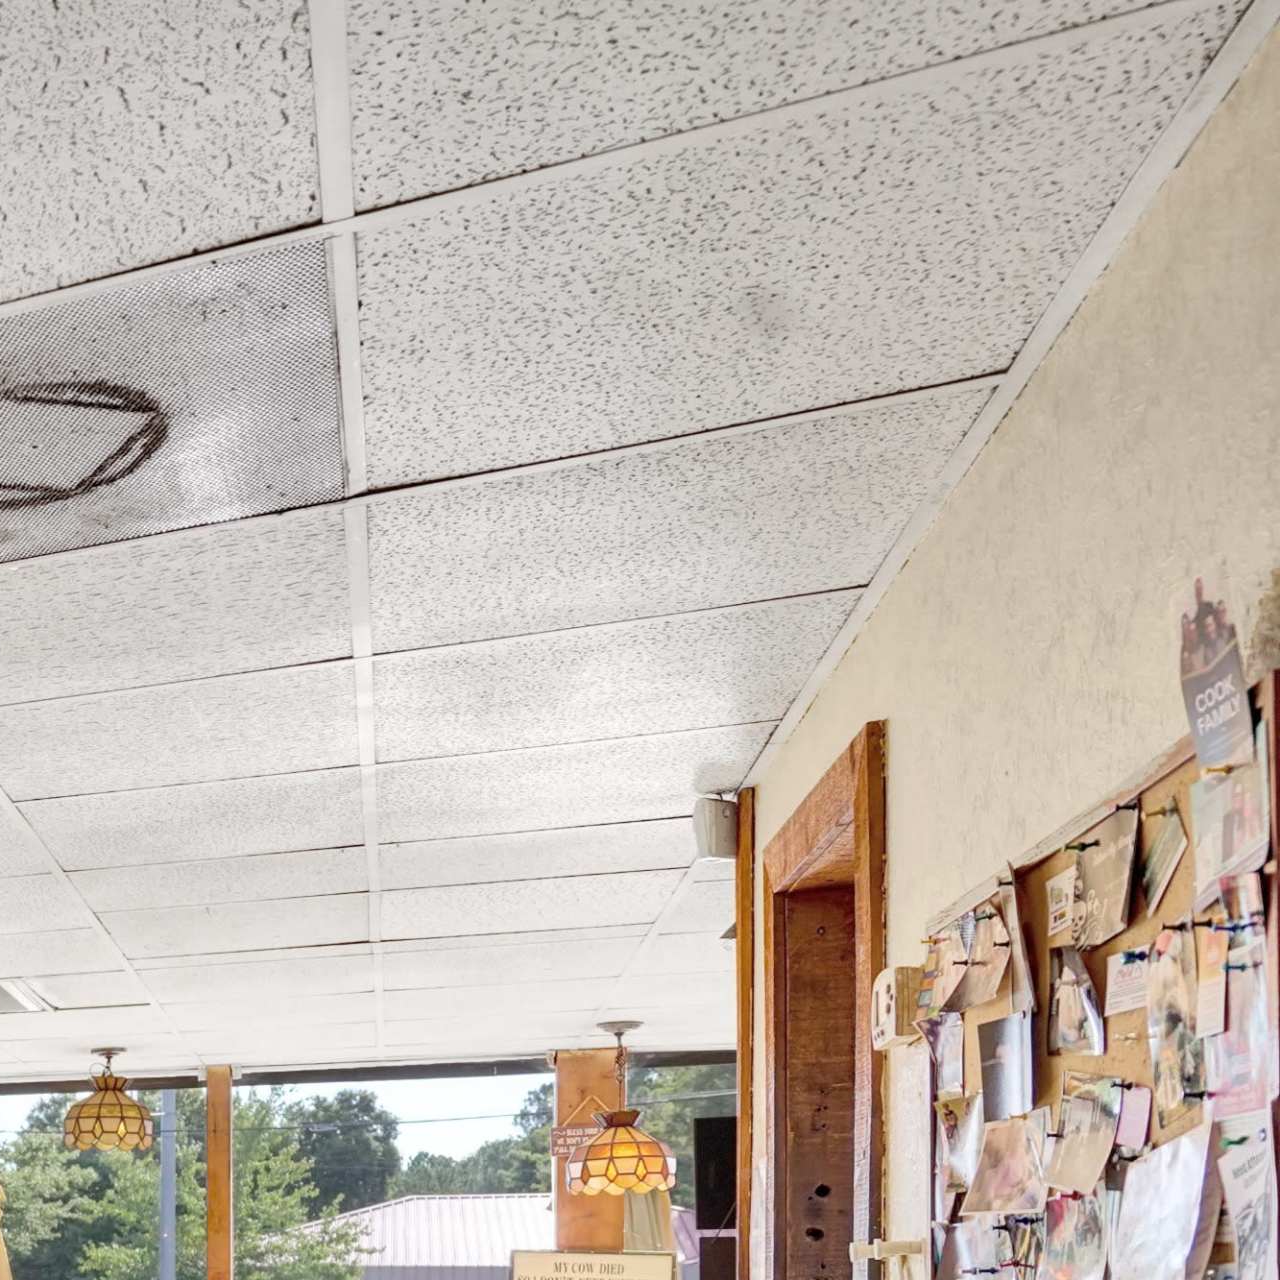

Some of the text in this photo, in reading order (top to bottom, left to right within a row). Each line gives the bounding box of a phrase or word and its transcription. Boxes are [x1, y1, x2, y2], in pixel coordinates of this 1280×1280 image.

[1195, 674, 1236, 713] COOK
[1197, 692, 1240, 736] FAMILY
[553, 1261, 625, 1275] MY COW DIED
